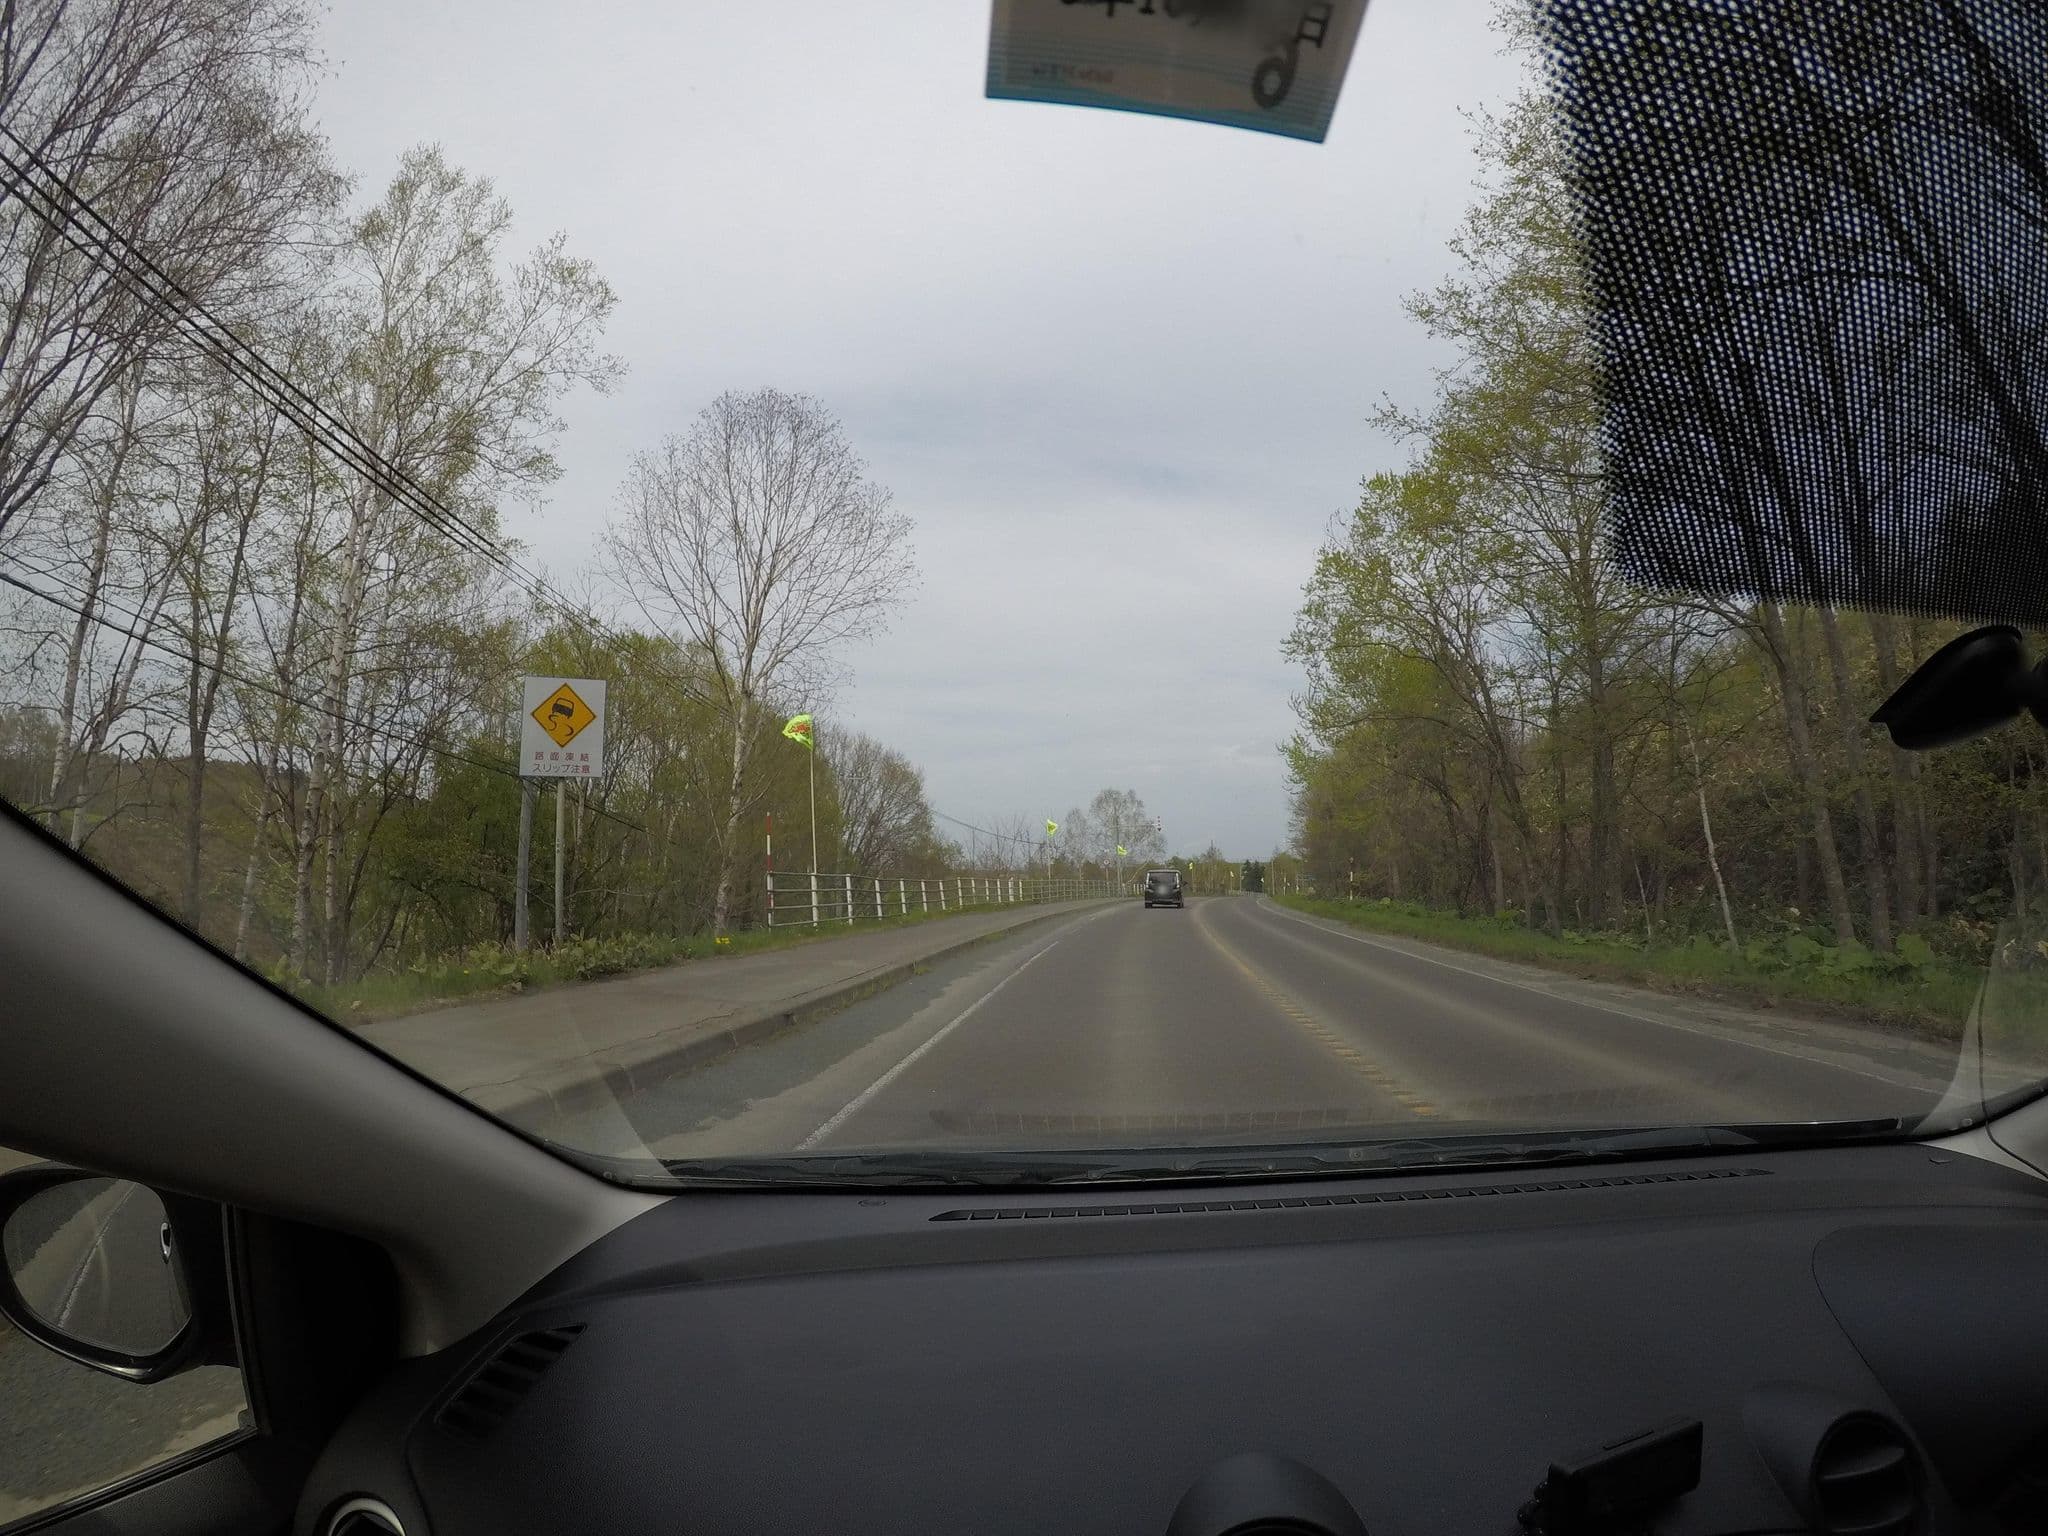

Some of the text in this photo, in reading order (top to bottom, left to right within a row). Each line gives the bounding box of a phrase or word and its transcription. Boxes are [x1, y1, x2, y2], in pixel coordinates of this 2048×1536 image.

[532, 763, 591, 774] スリップ注意
